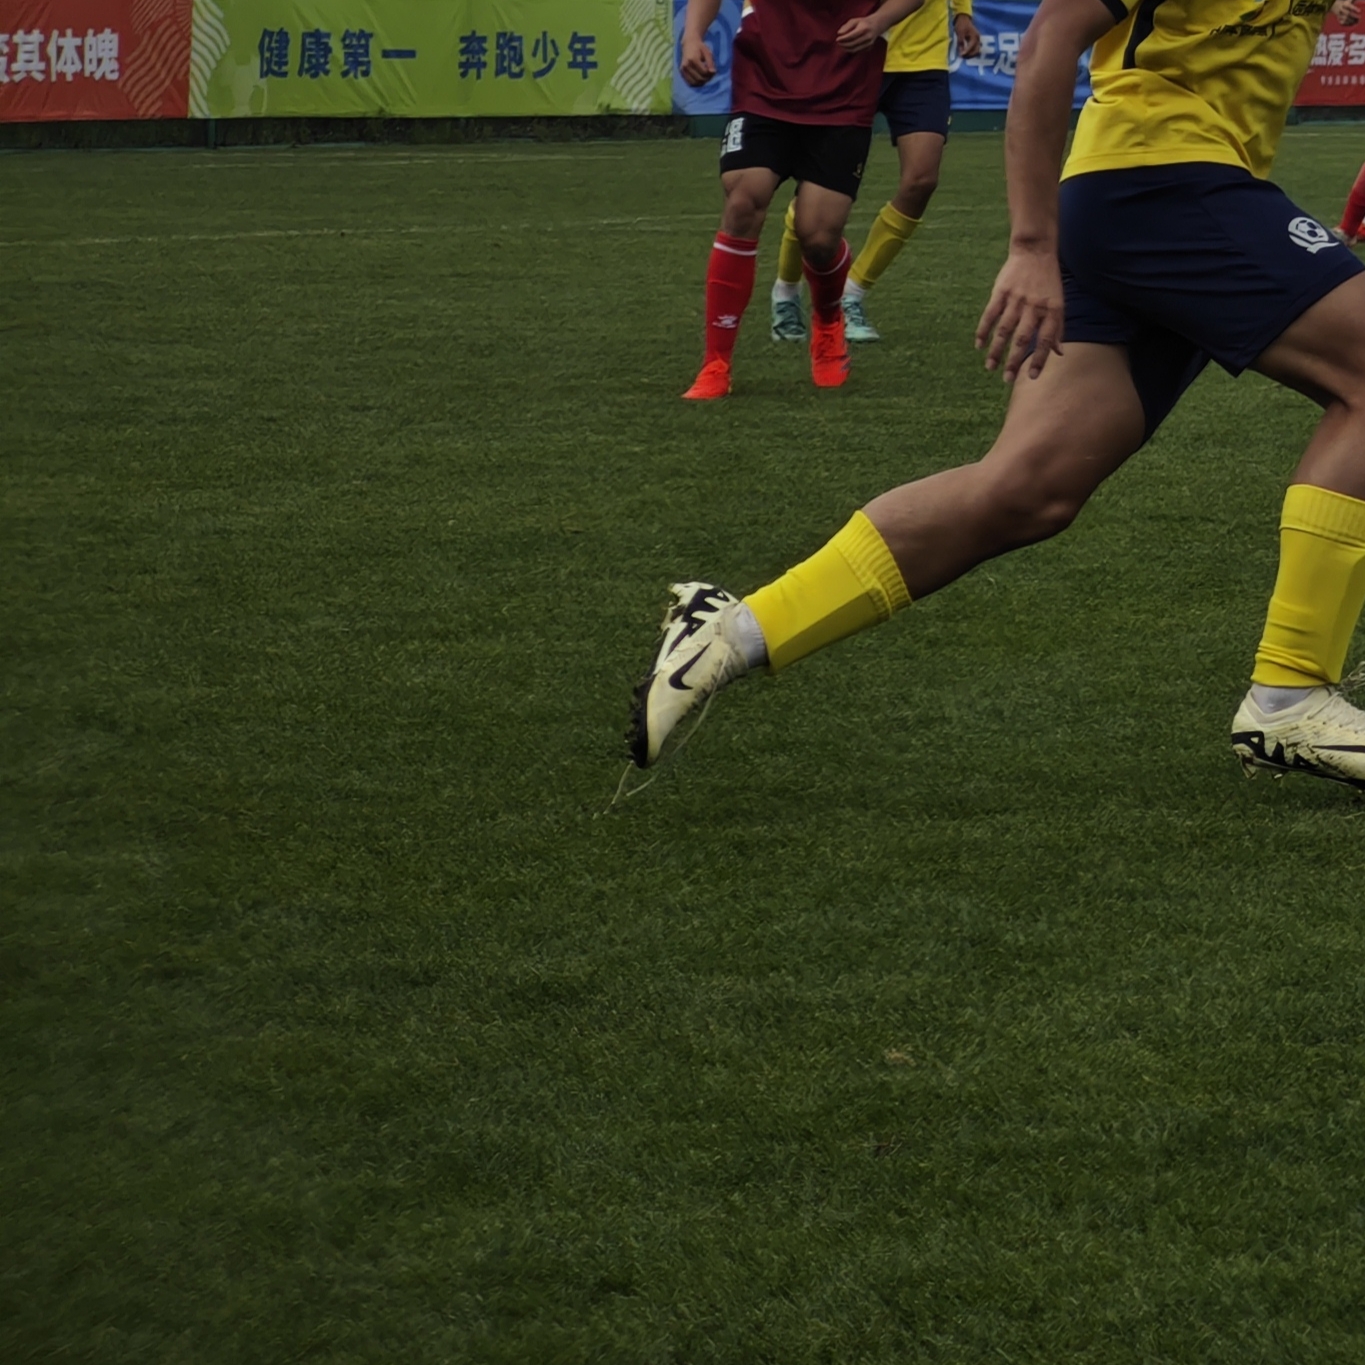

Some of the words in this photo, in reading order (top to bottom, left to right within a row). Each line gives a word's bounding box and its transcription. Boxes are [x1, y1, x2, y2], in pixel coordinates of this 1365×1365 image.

[0, 27, 120, 83] 其体魄
[258, 27, 418, 81] 健康第一
[458, 29, 599, 82] 奔跑少年
